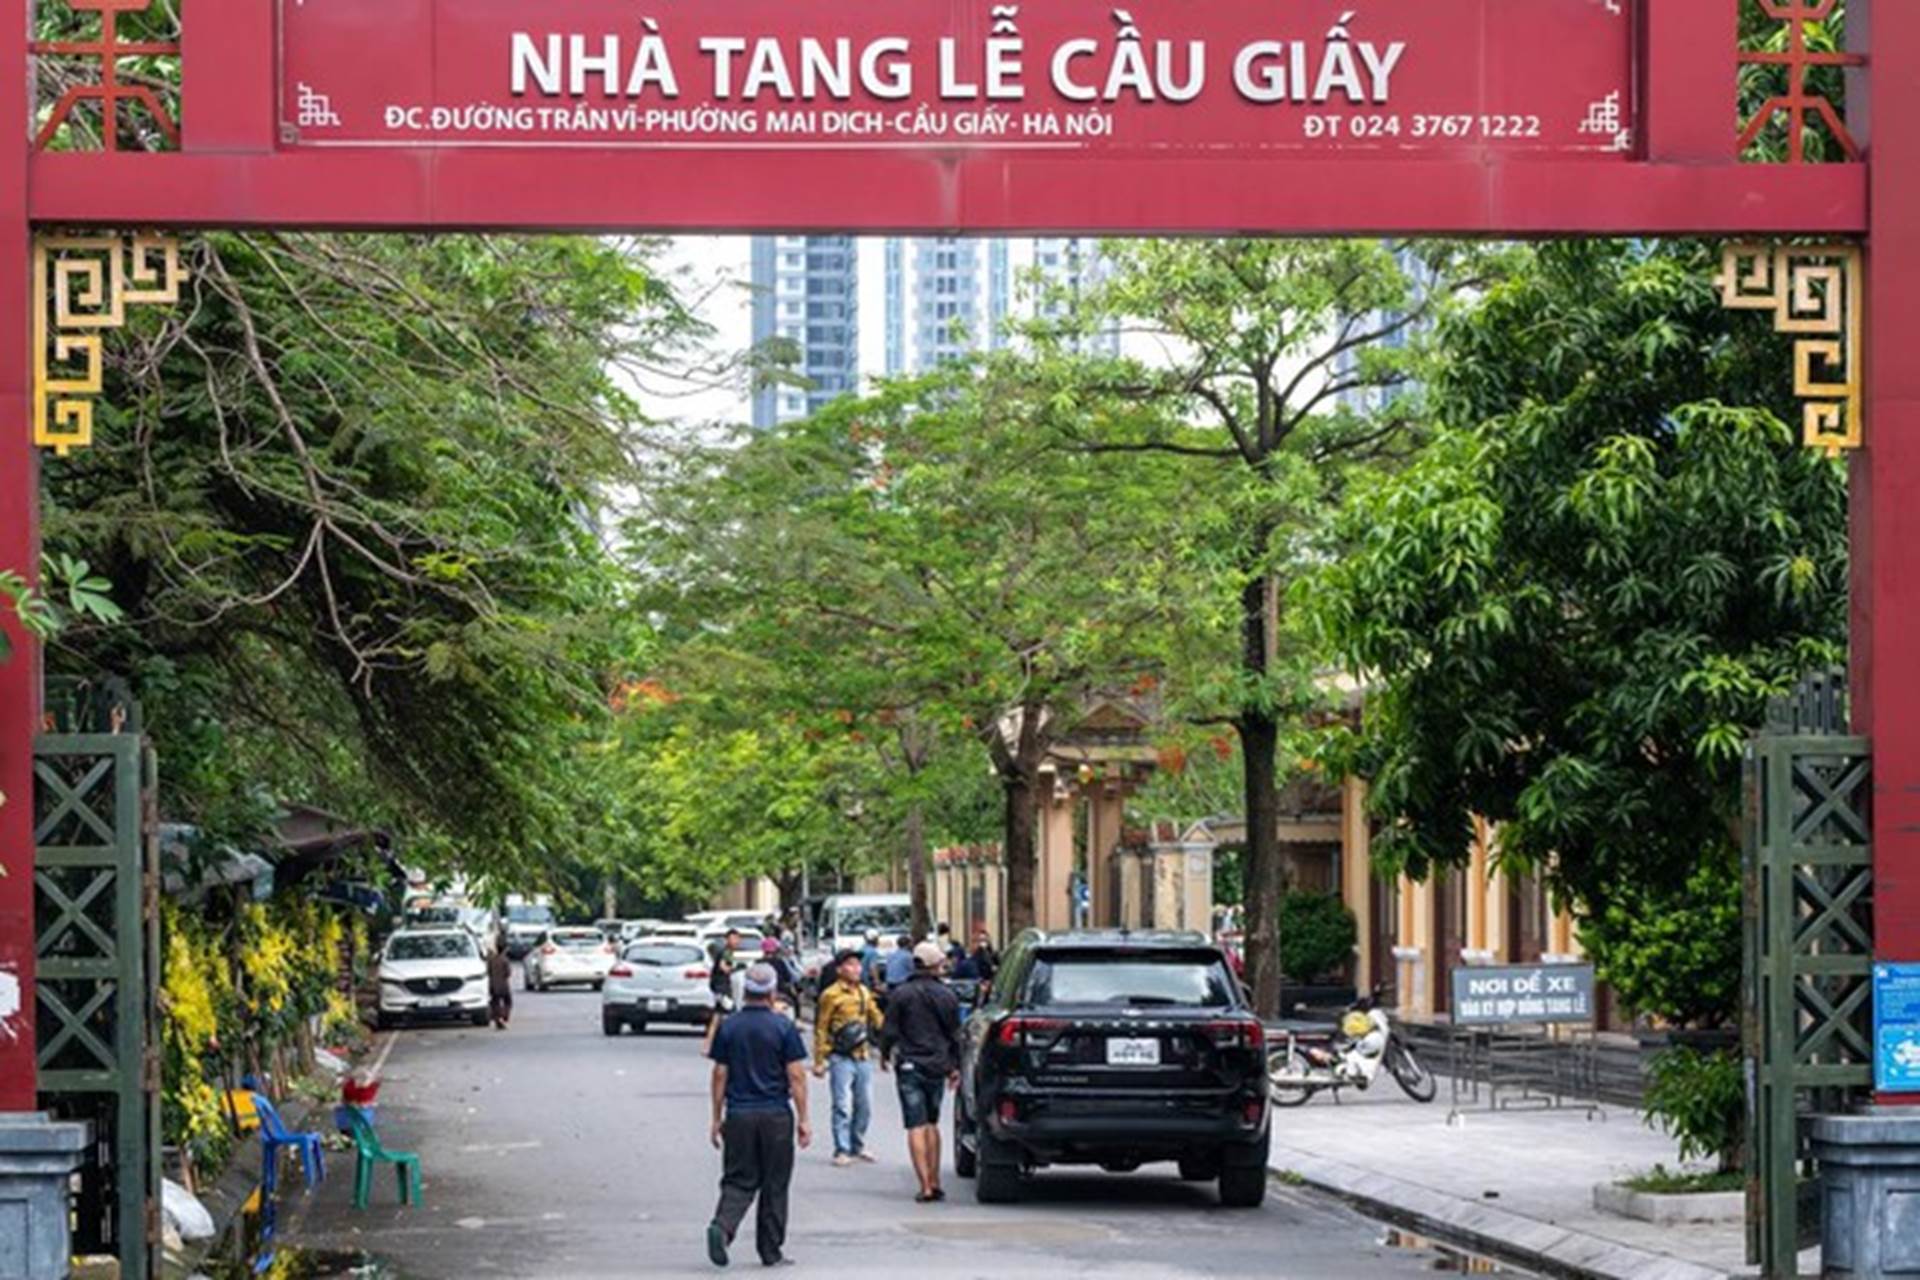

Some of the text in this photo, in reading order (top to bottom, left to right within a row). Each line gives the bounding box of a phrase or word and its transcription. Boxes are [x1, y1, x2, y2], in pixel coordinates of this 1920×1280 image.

[511, 4, 1406, 101] NHÀ TANG LỄ CẦU GIẤY
[766, 110, 817, 134] MAI
[1022, 108, 1061, 136] HÀ
[1303, 114, 1541, 138] ĐT 024 3767 1222
[1546, 976, 1577, 992] XE
